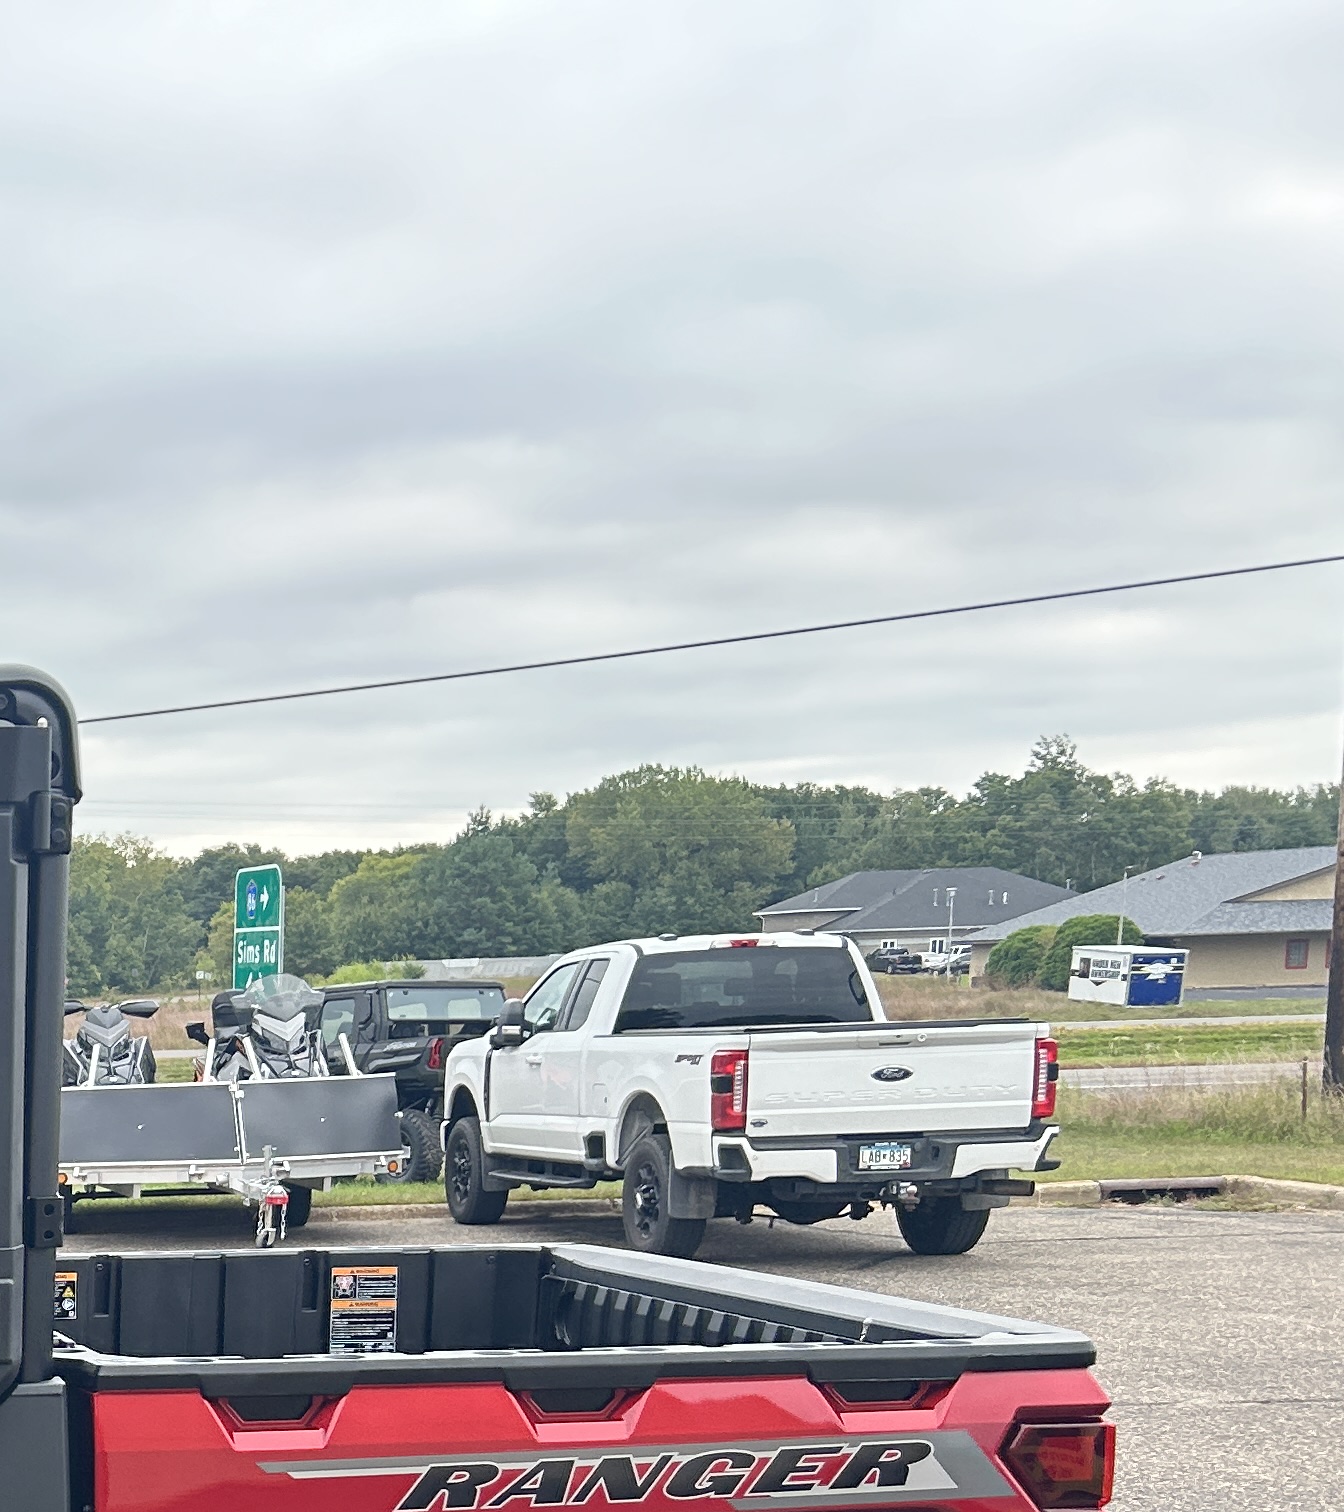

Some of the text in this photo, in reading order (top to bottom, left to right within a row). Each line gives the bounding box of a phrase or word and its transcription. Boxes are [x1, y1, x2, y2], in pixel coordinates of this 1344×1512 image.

[237, 939, 277, 964] Sims Rd
[764, 1083, 1018, 1104] SUPER DUTY
[393, 1440, 932, 1512] RANGER
